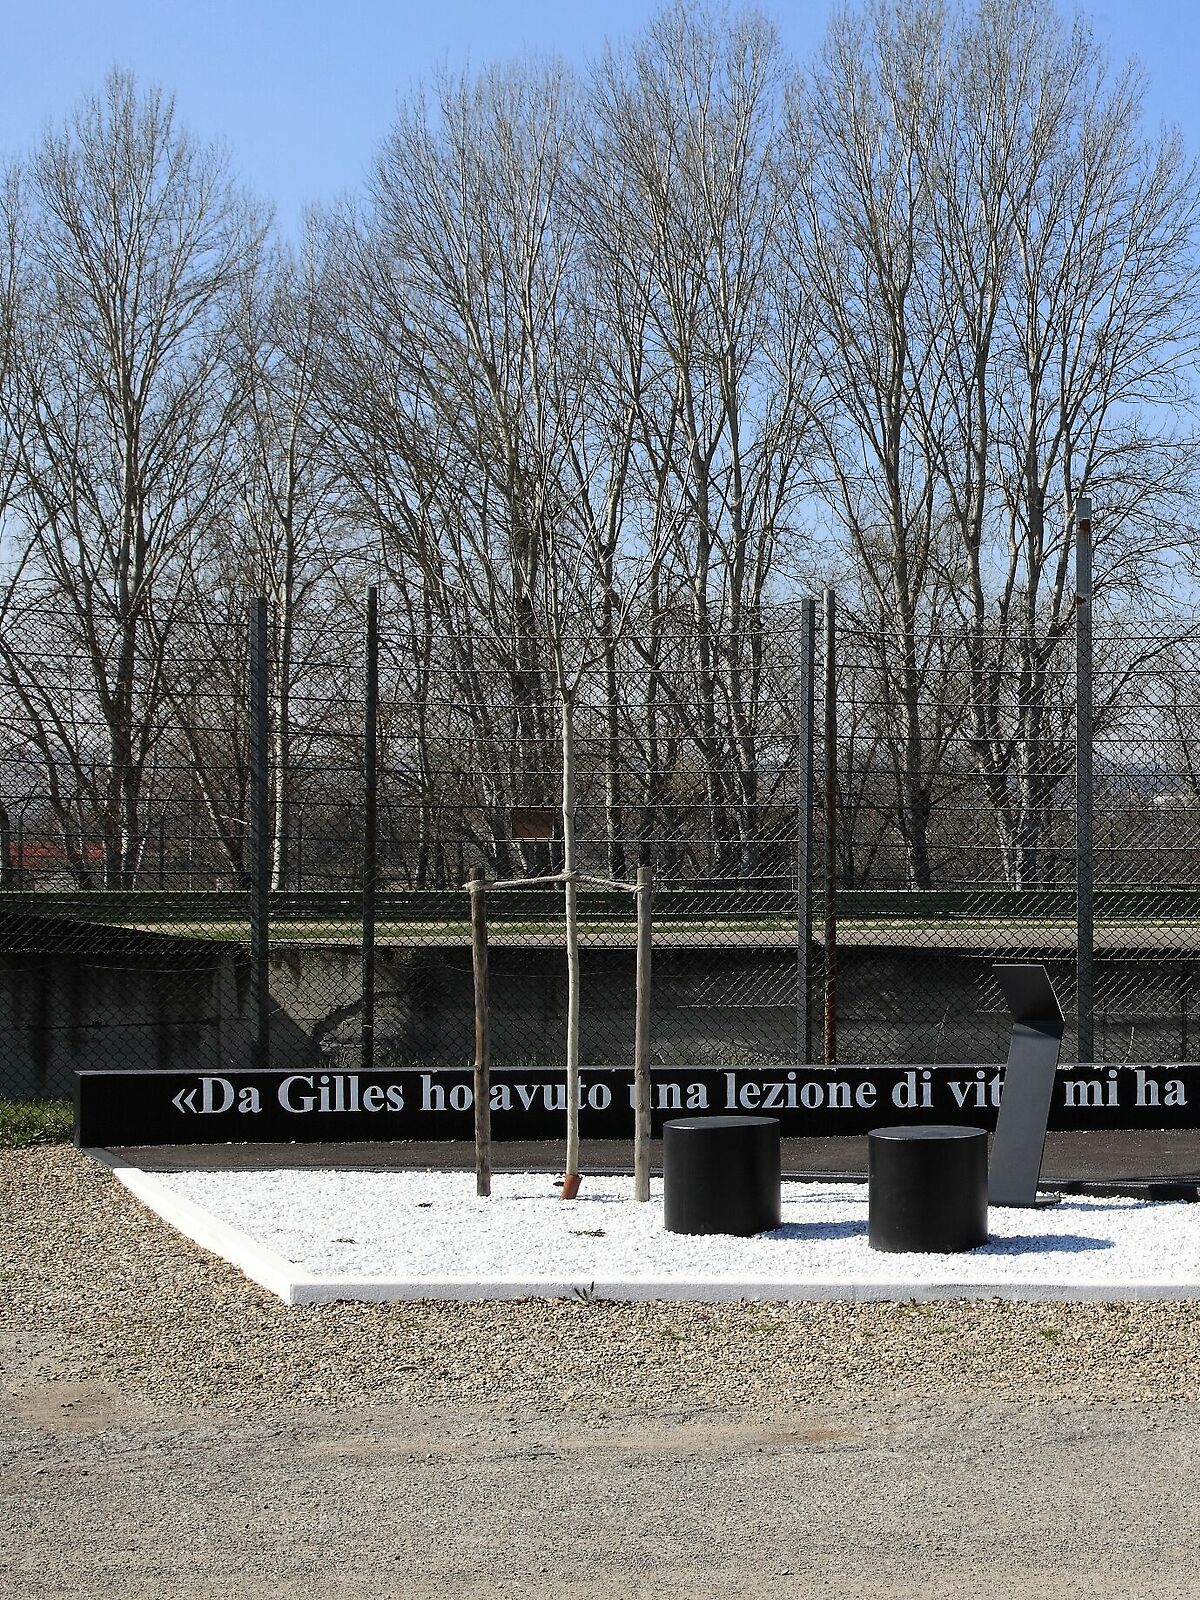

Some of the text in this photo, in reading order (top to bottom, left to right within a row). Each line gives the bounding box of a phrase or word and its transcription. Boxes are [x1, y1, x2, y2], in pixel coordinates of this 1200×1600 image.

[171, 1077, 263, 1114] «Da
[277, 1075, 404, 1114] Gilles
[420, 1074, 473, 1111] ho
[723, 1071, 877, 1110] lezione
[891, 1070, 935, 1109] di
[947, 1070, 1005, 1107] vit
[1063, 1070, 1120, 1107] mi
[1131, 1070, 1188, 1107] ha
